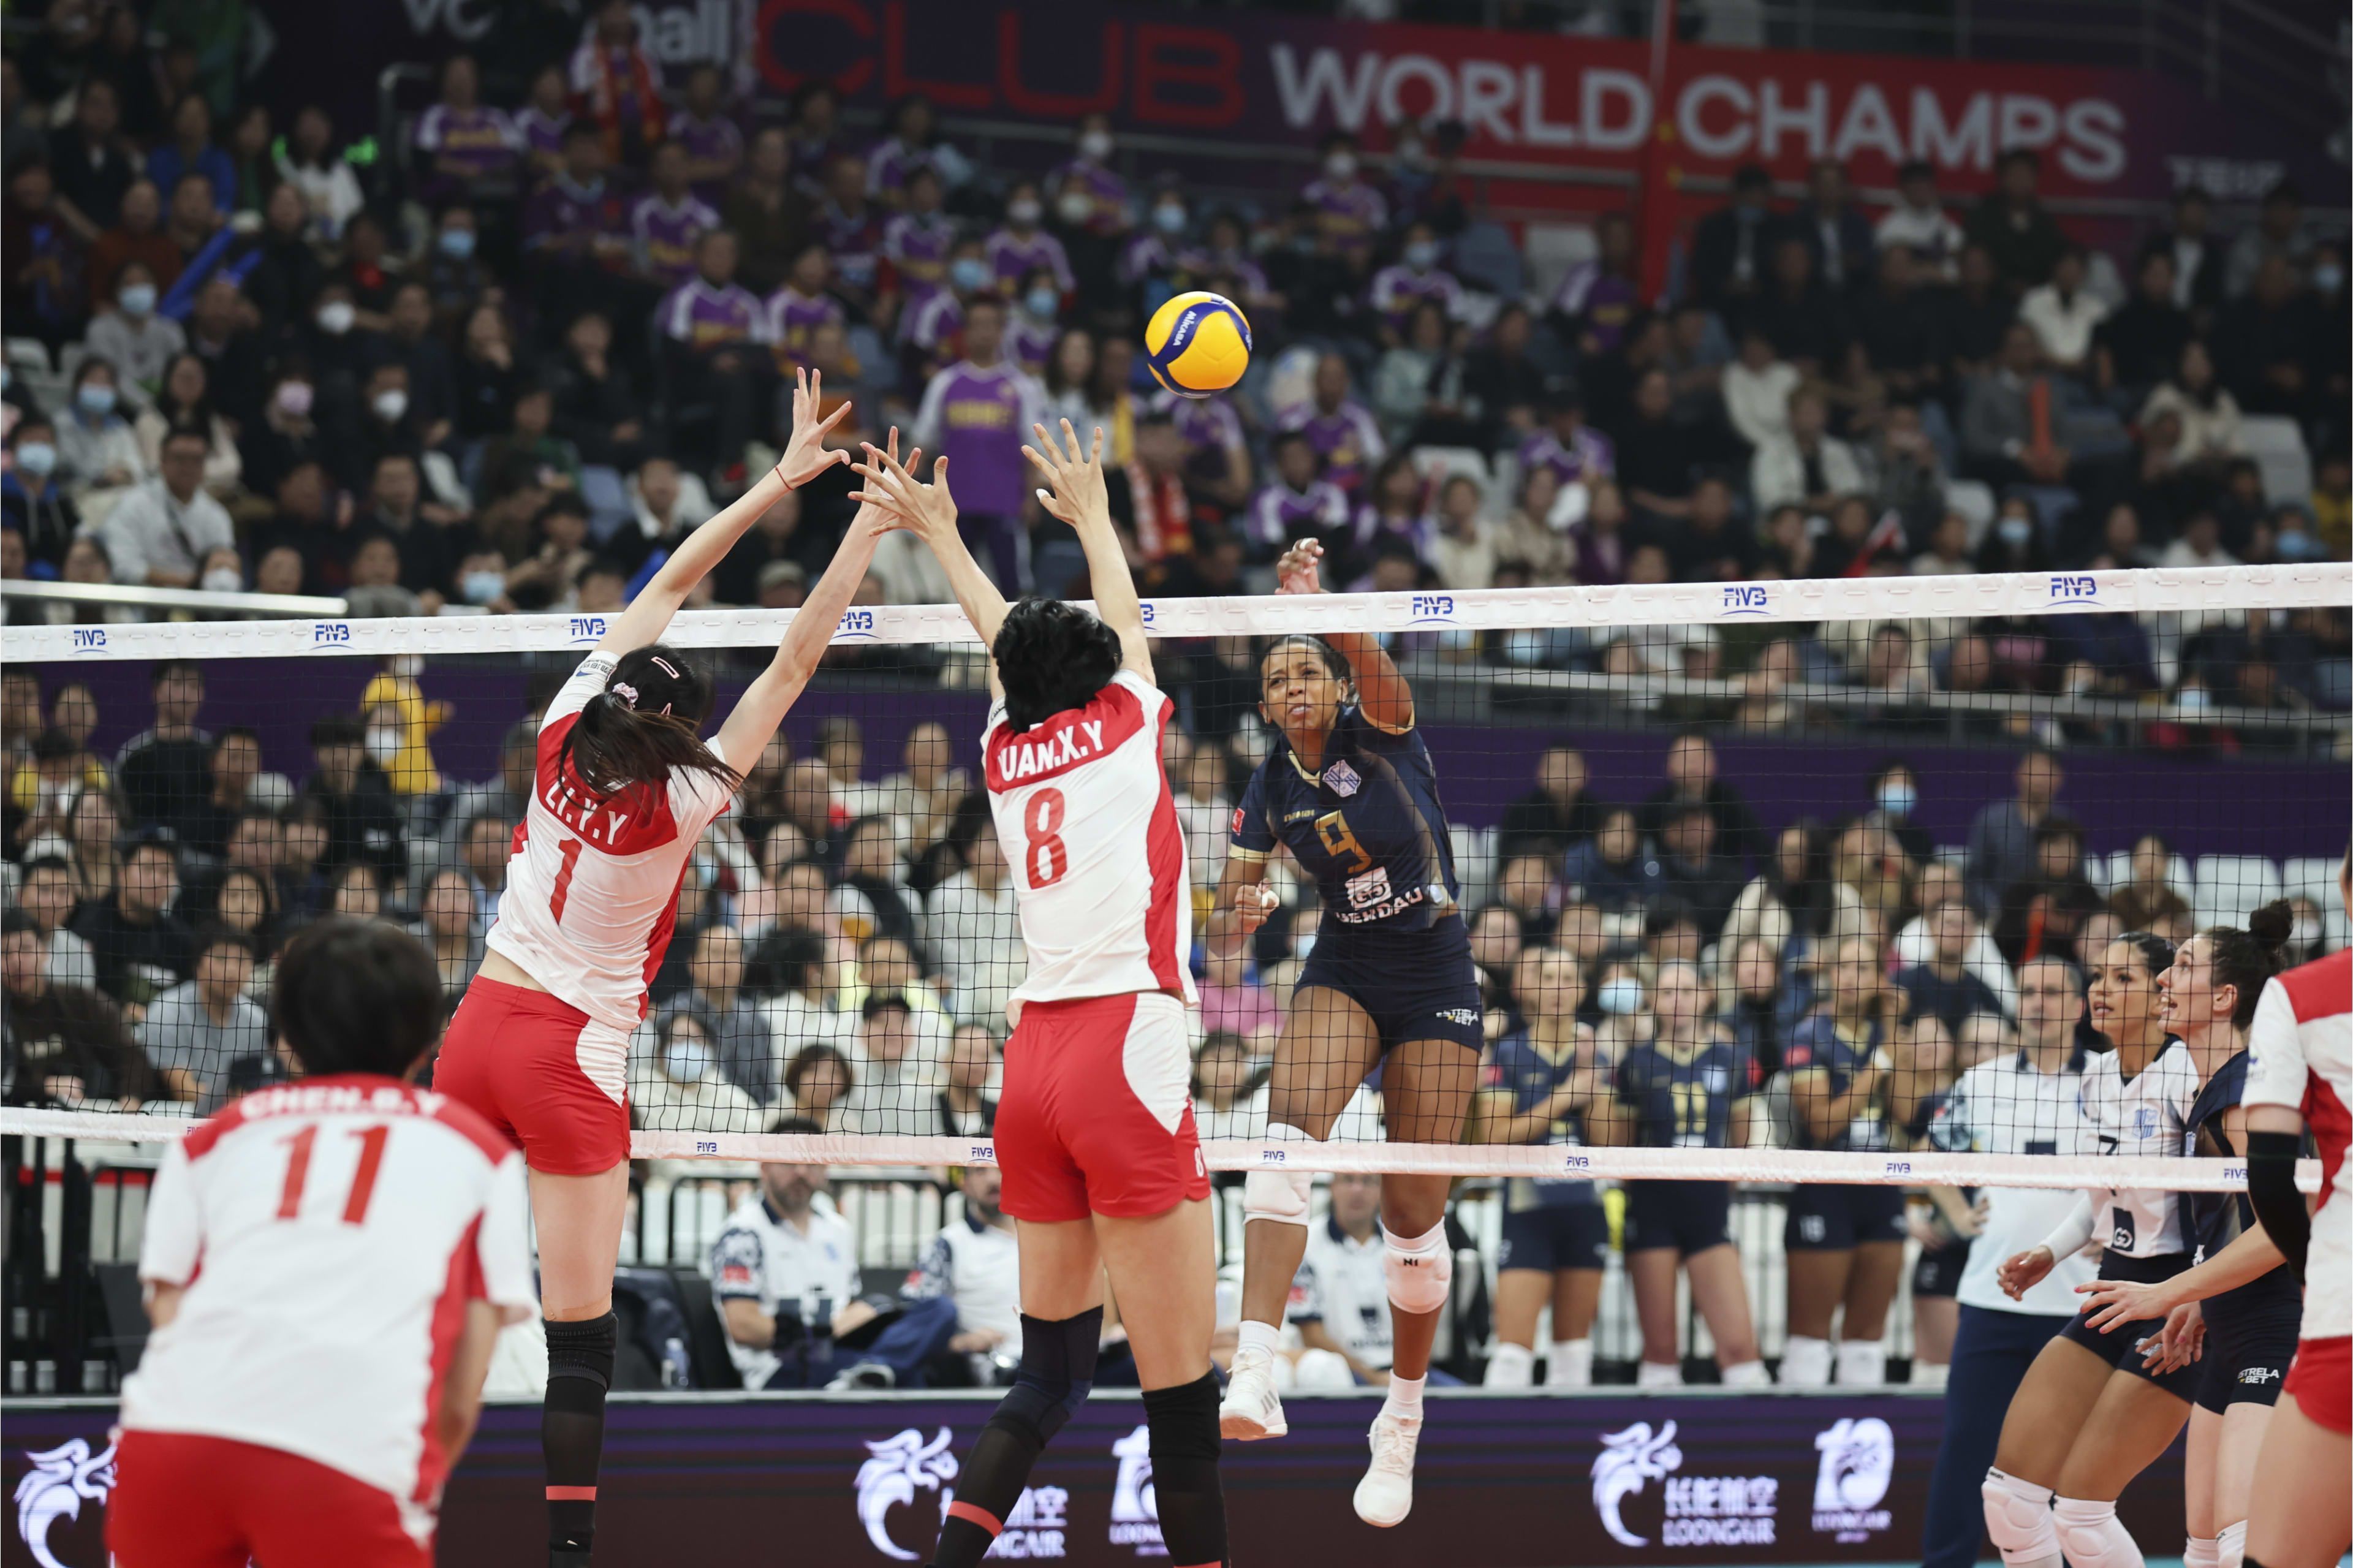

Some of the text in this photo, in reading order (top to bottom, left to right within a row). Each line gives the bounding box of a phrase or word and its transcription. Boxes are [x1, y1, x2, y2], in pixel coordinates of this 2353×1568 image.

[756, 0, 1246, 124] CLUB
[1270, 41, 1654, 151] WORLD
[1677, 74, 2126, 181] CHAMPS
[1724, 587, 1767, 606] FIVB
[2050, 577, 2097, 597] FIVB
[1413, 596, 1453, 615] FIVB
[315, 624, 349, 641] FIVB
[570, 618, 605, 636] FIVB
[74, 629, 107, 646] FIVB
[998, 720, 1104, 782] UAN.X.Y
[1025, 787, 1067, 890] 8
[1314, 809, 1372, 873] 9
[549, 838, 582, 926] 1
[697, 1142, 717, 1152] FIVB
[971, 1147, 993, 1157] FIVB
[1263, 1150, 1285, 1161] FIVB
[1194, 1146, 1204, 1177] 8
[1567, 1156, 1589, 1167] FIVB
[1887, 1162, 1911, 1173] FIVB
[275, 1124, 390, 1224] 11
[2245, 1375, 2269, 1384] BET
